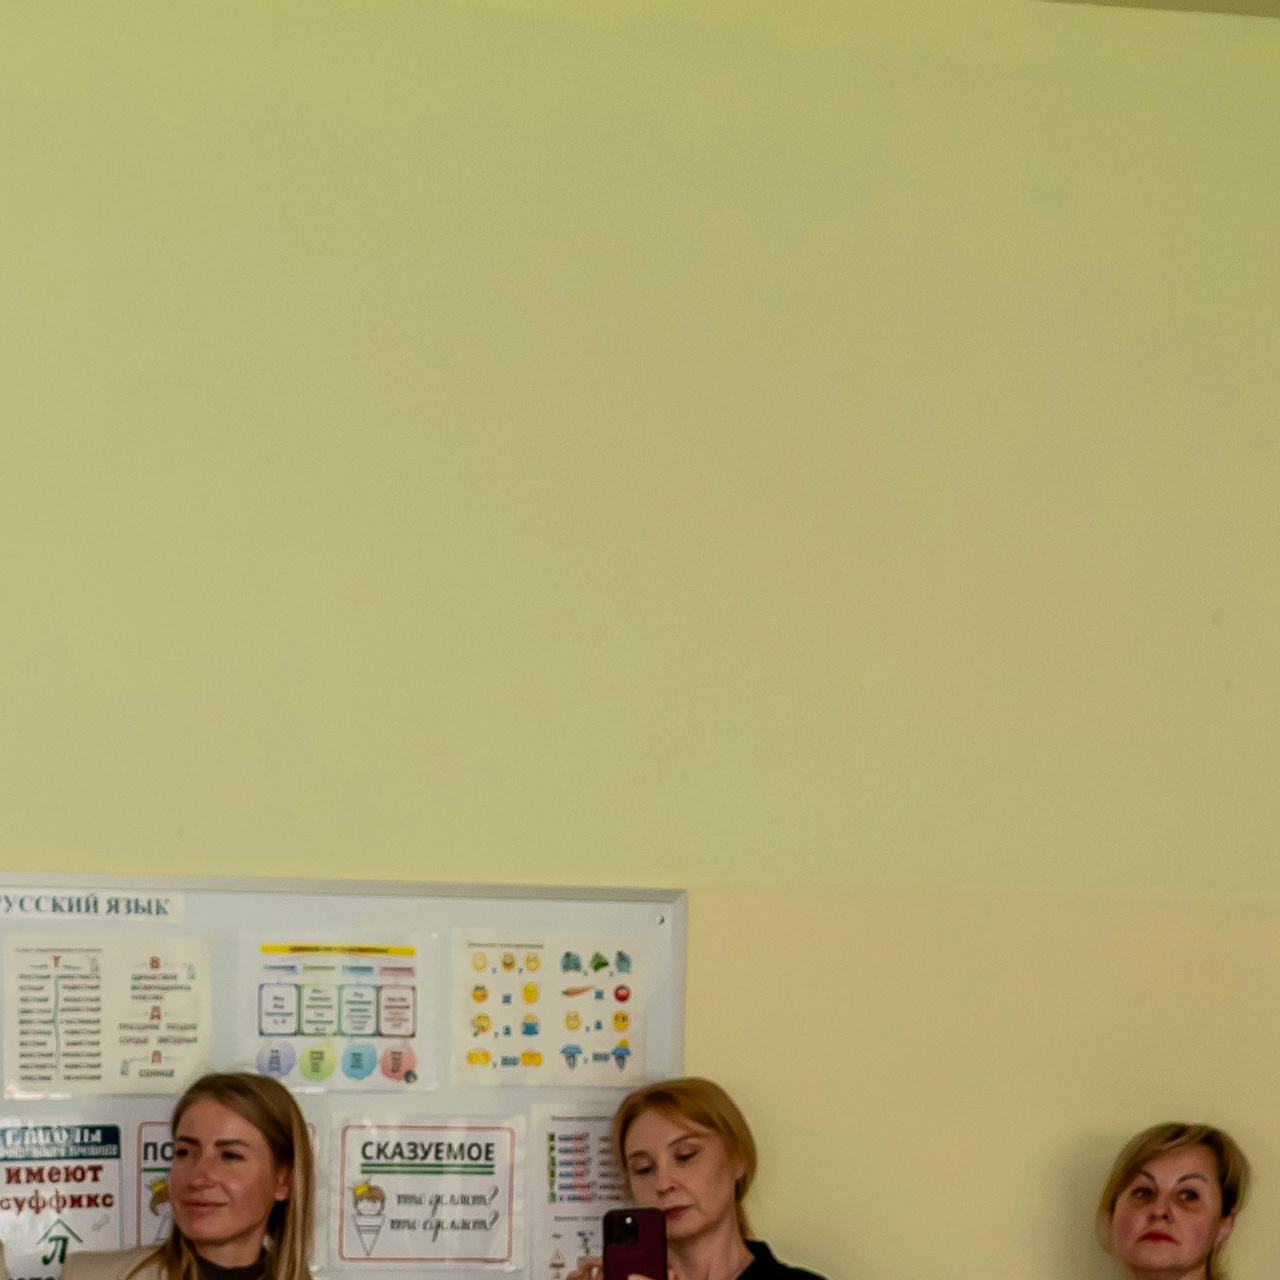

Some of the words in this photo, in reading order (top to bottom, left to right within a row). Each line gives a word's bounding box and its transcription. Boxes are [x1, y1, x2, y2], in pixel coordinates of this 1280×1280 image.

[105, 898, 170, 916] ЯЗЫК
[361, 1141, 496, 1161] СКАЗУЕМОЕ
[5, 1165, 104, 1185] имеют
[0, 1189, 115, 1215] суффикс
